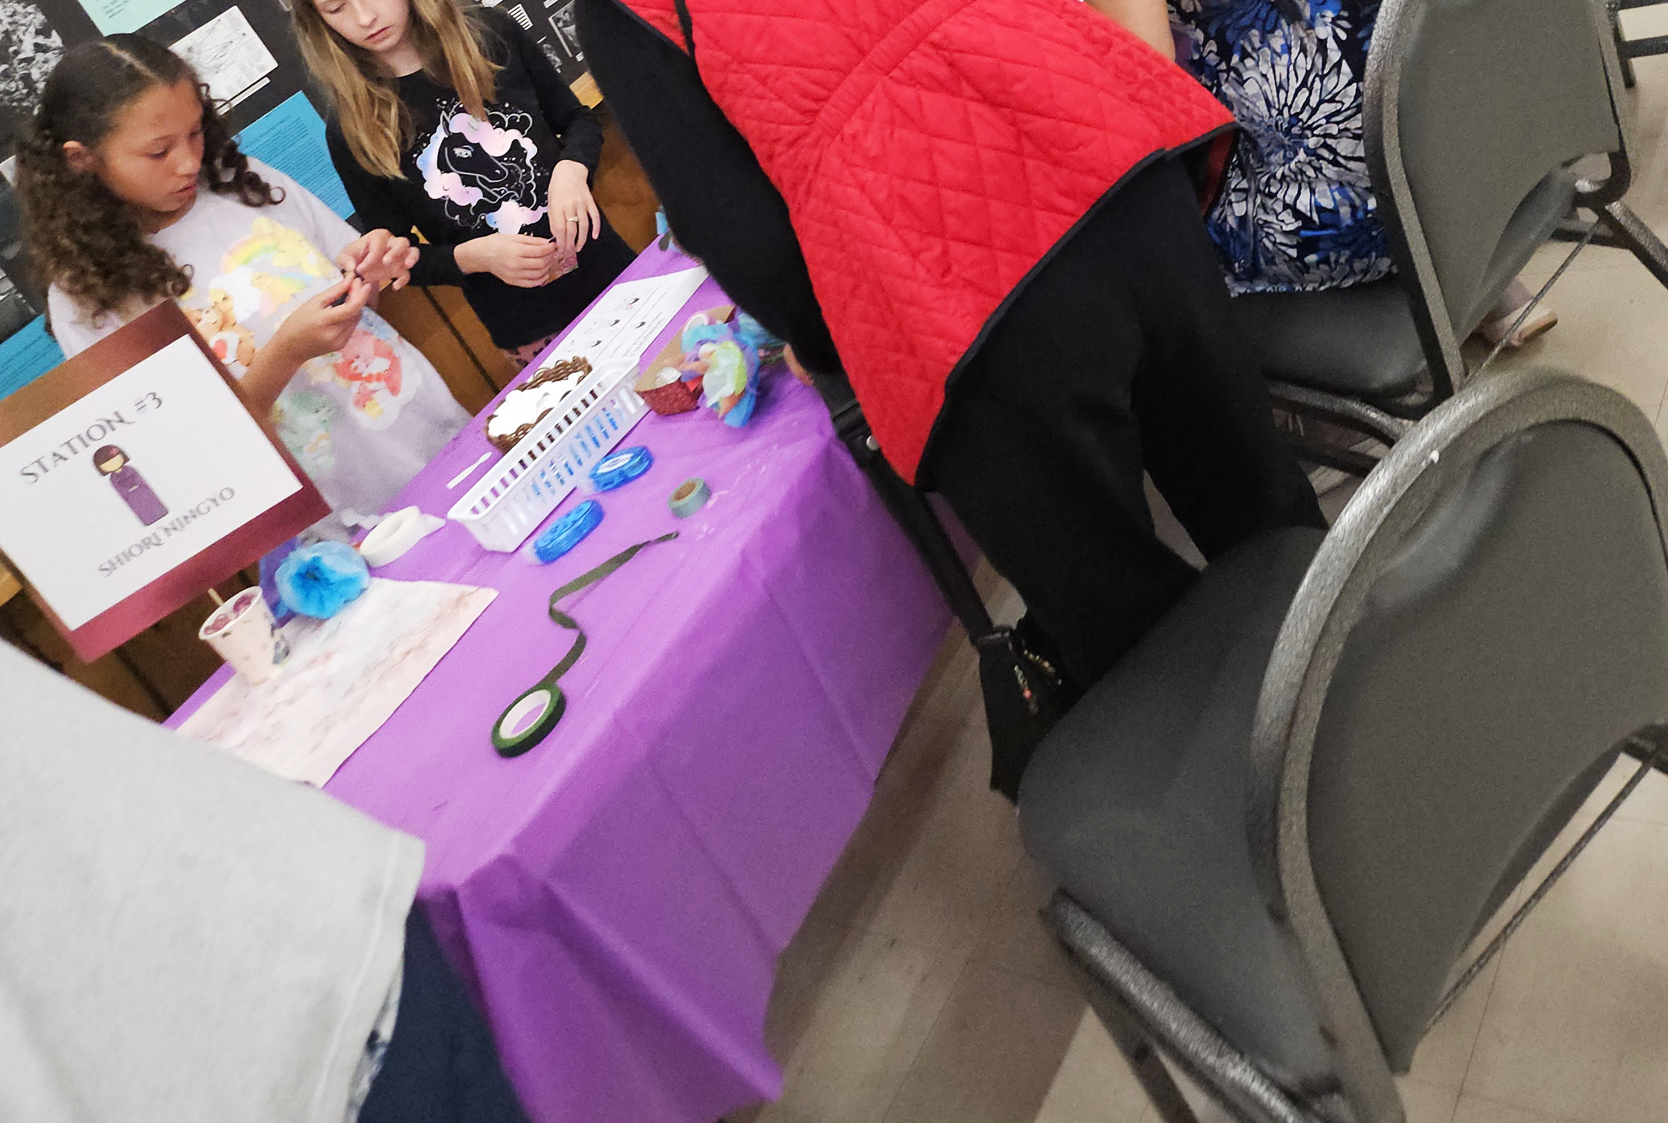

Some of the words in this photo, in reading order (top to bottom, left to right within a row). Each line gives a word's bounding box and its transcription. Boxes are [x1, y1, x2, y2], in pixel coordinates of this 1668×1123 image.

[20, 410, 136, 484] STATION
[98, 530, 165, 577] SHIORI
[158, 486, 236, 538] NINGYO
